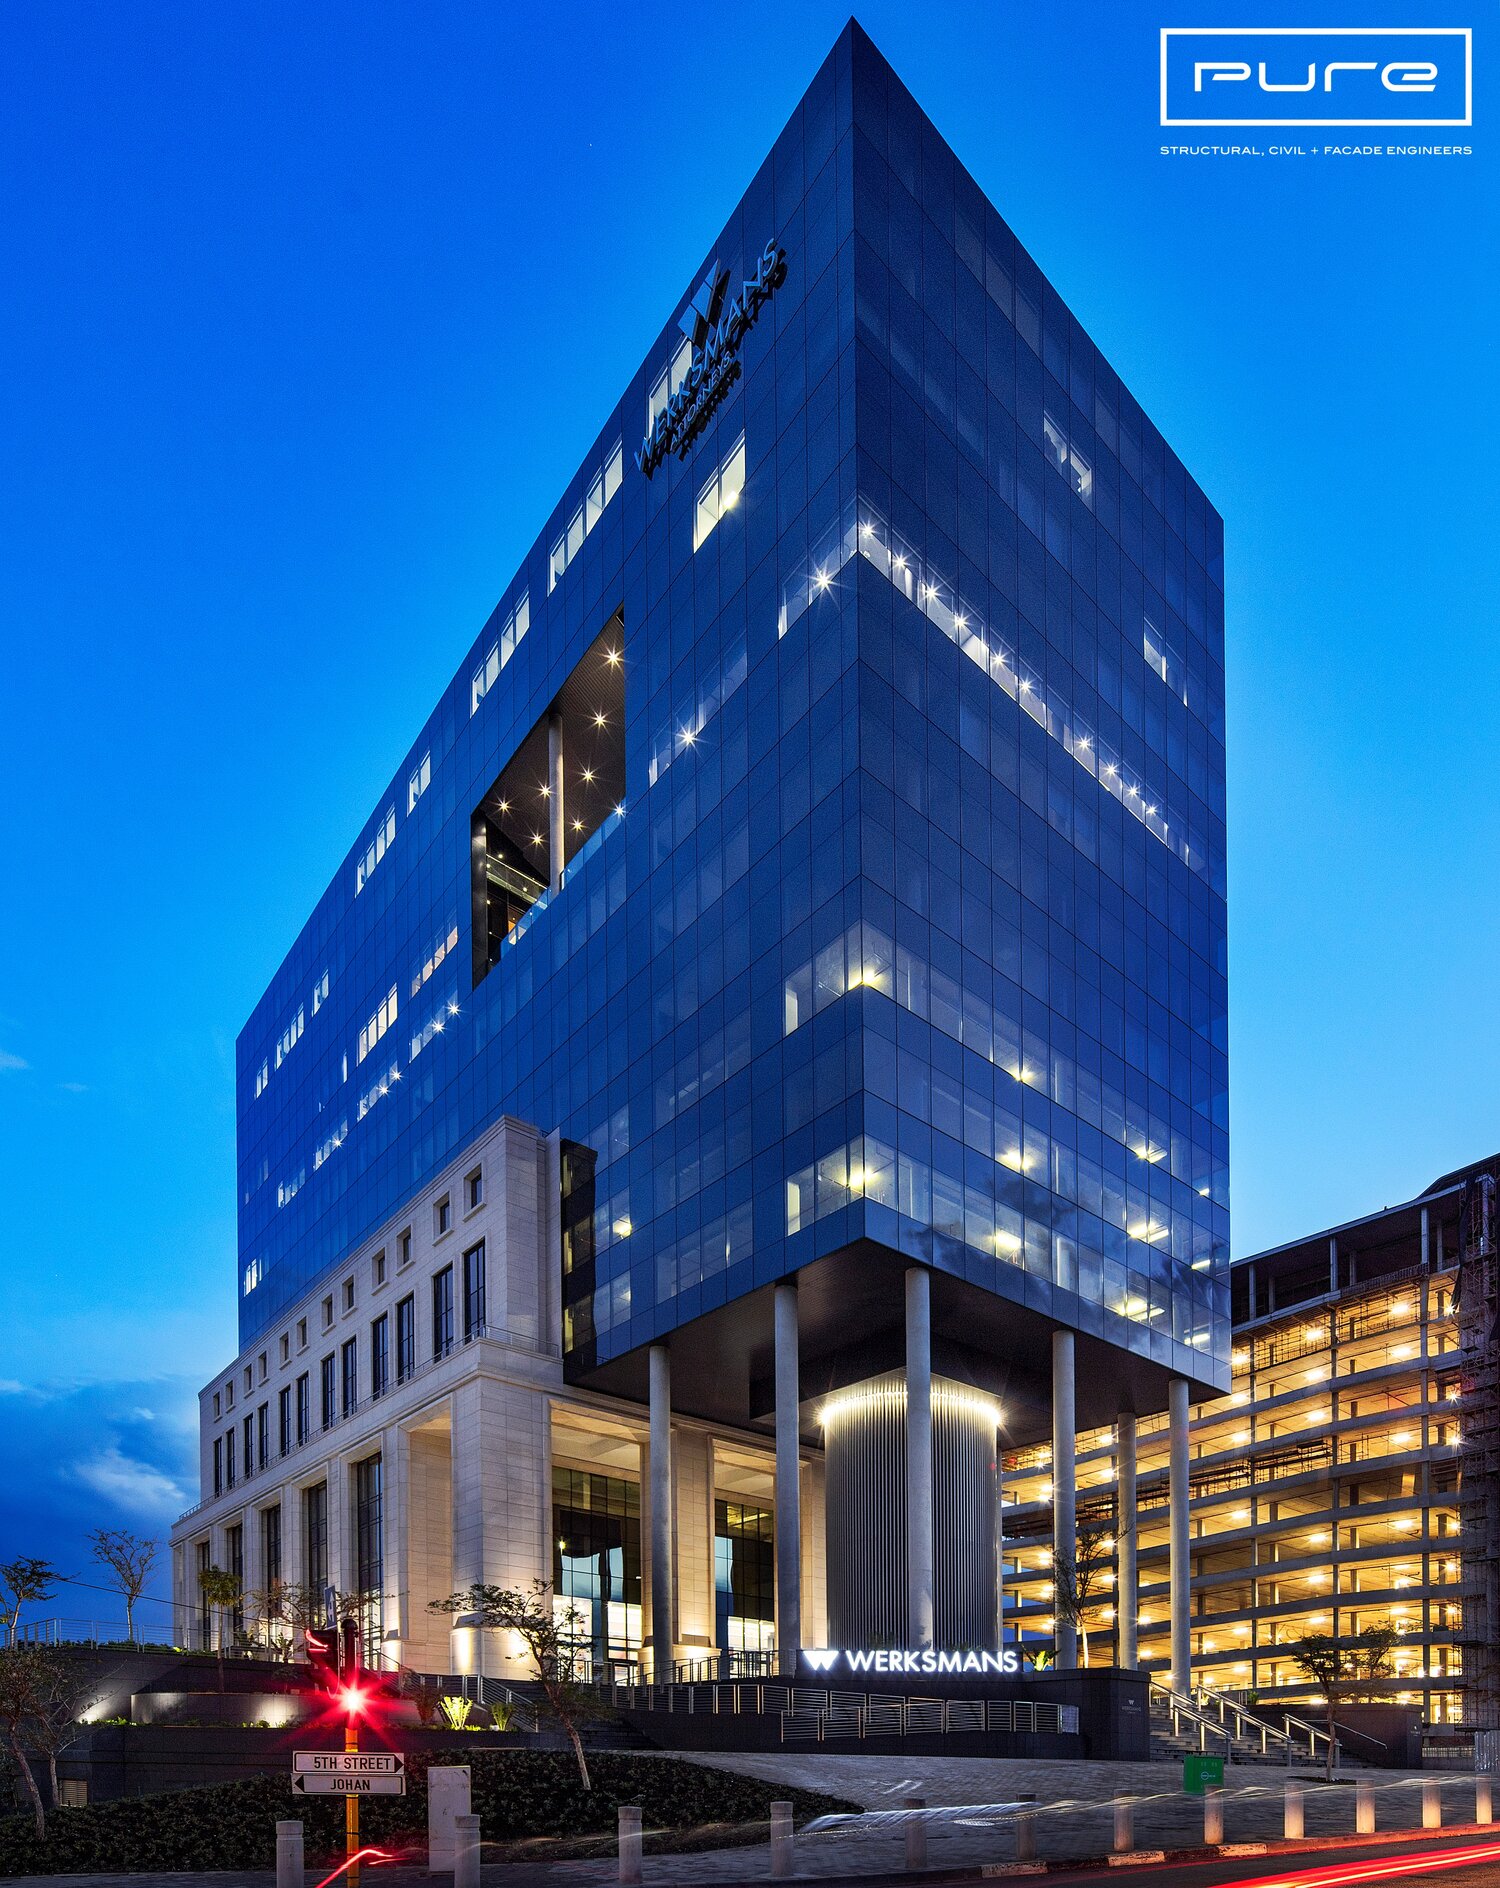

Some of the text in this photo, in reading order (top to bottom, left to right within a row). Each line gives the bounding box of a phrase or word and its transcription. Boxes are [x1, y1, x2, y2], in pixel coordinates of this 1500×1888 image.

[634, 238, 779, 472] WERKSMANS
[846, 1651, 1018, 1672] WERKSMANS
[314, 1757, 391, 1769] 5TH STREET
[330, 1779, 370, 1790] JOHAN
